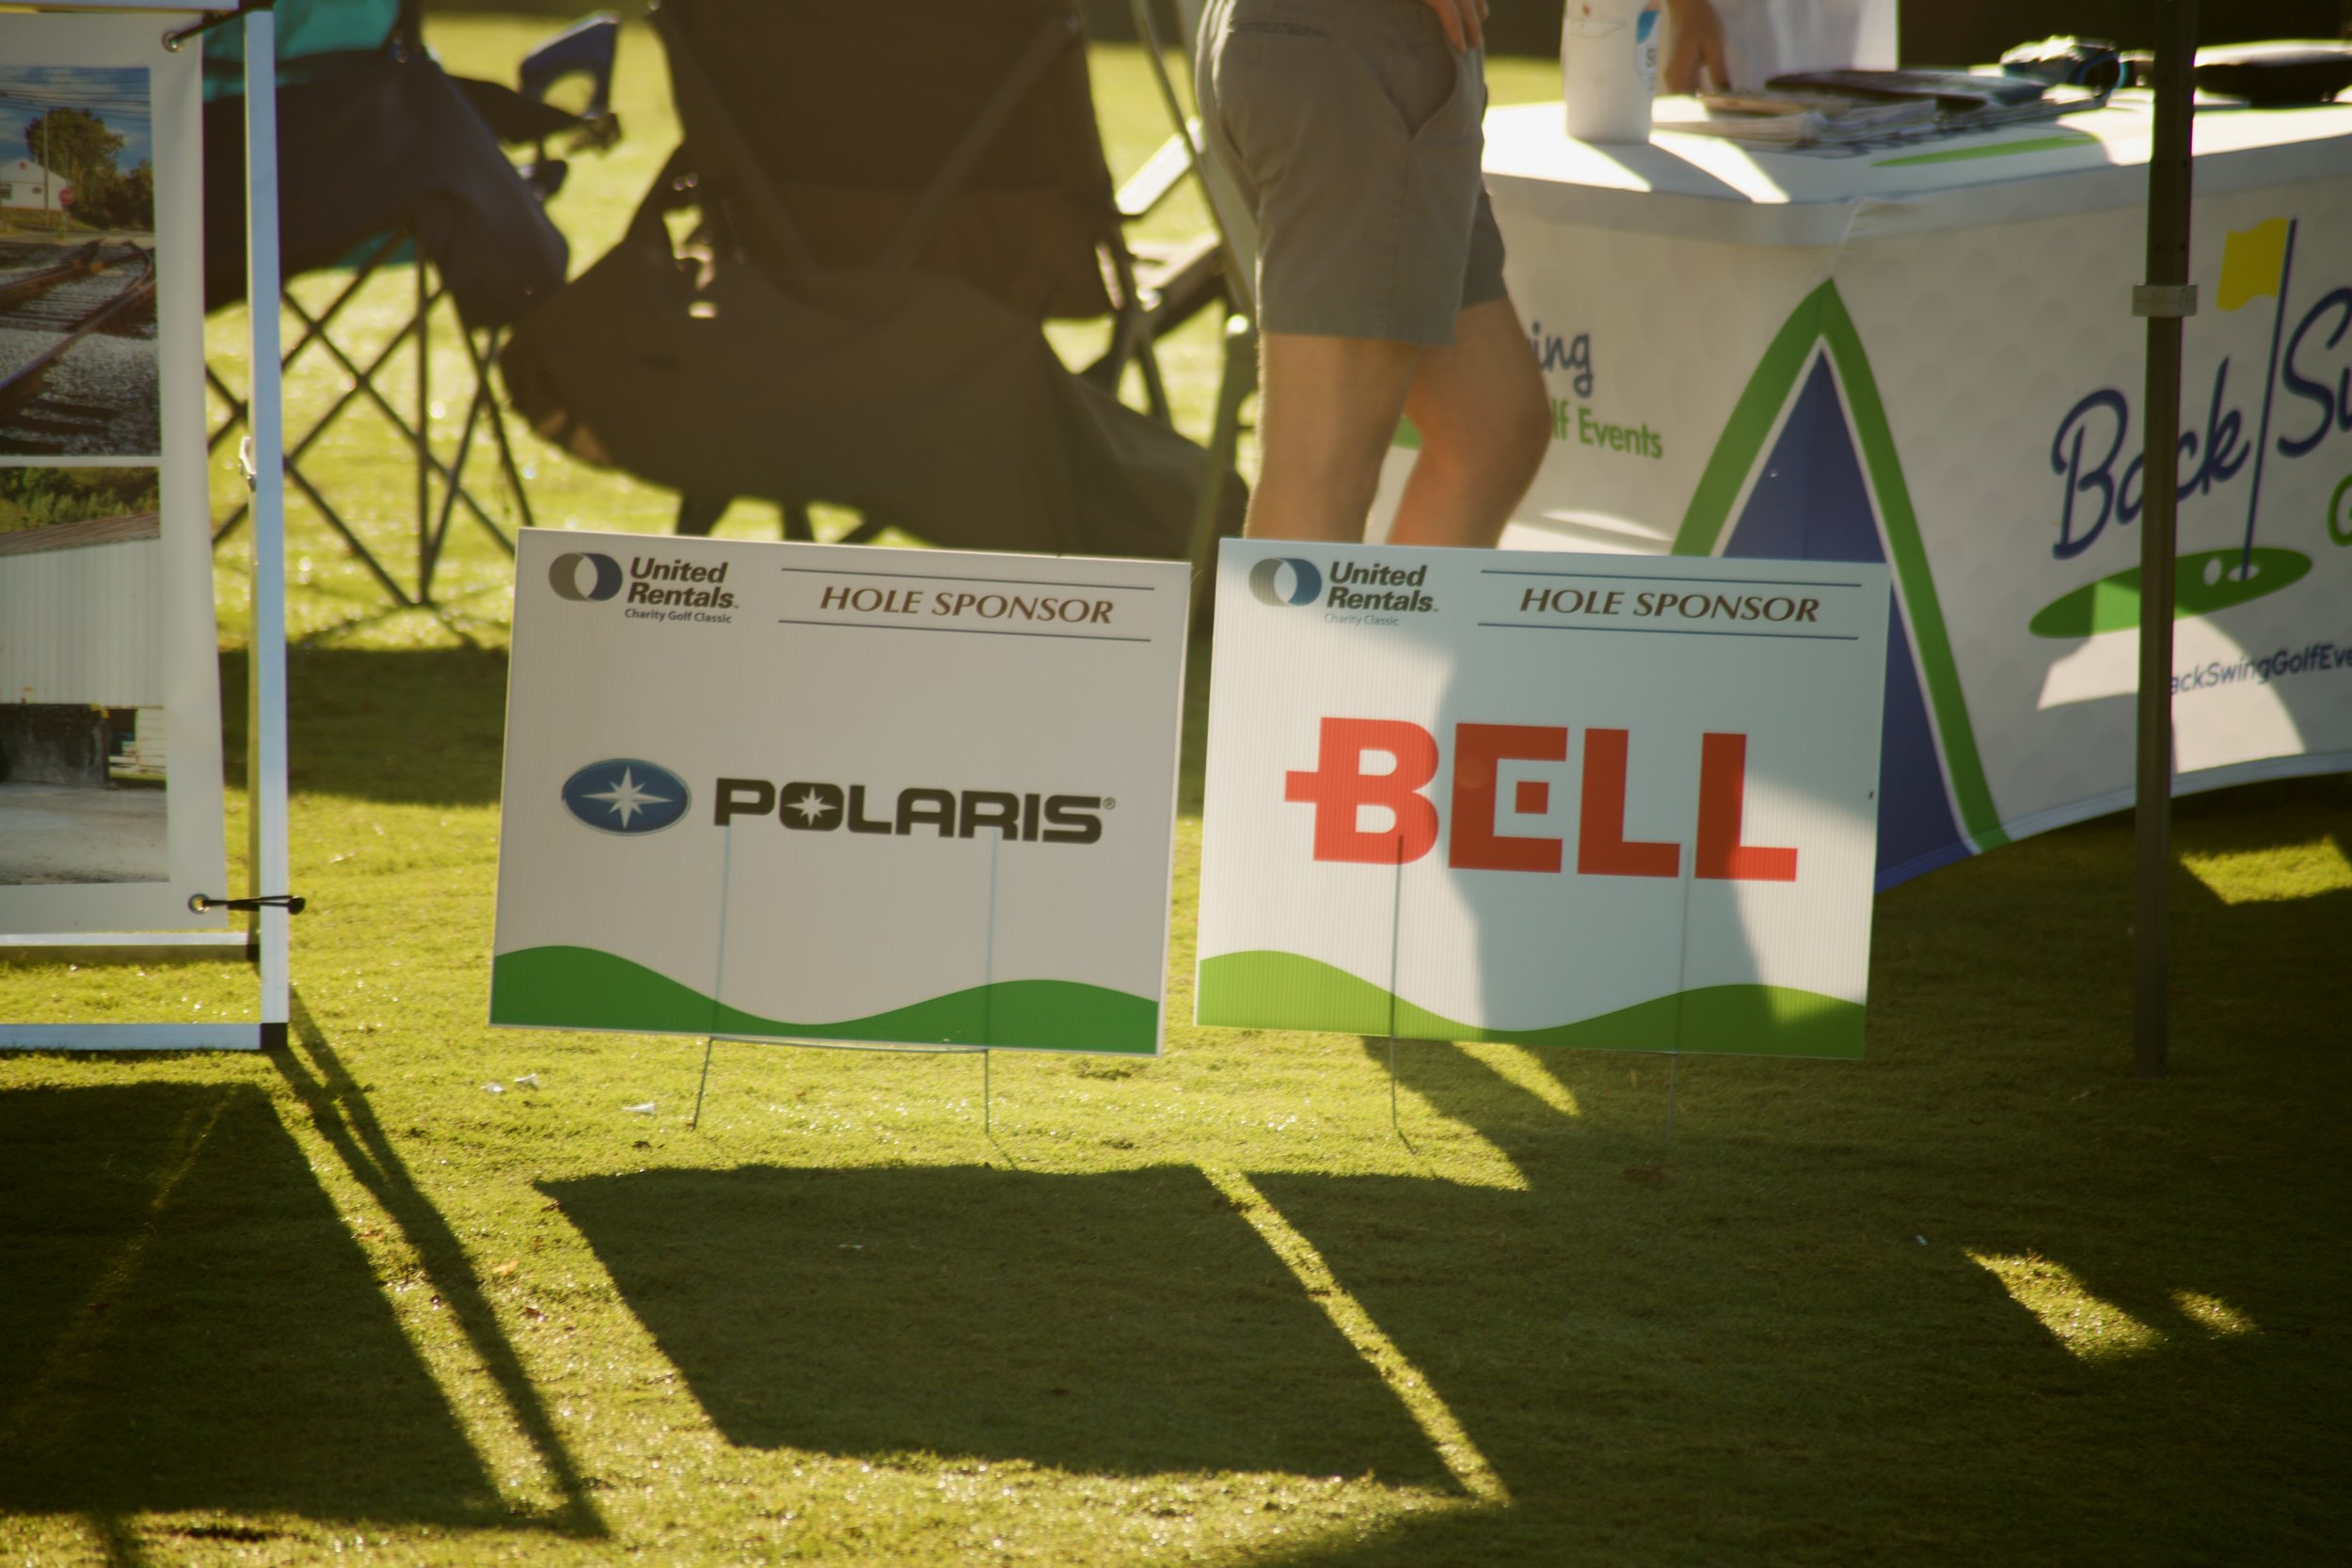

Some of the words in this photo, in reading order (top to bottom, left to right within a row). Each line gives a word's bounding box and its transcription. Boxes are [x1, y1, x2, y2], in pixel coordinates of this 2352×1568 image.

[1578, 406, 1663, 460] Events
[629, 557, 729, 584] United
[1329, 562, 1427, 587] United
[627, 581, 735, 610] Rentals
[819, 586, 924, 614] HOLE
[930, 592, 1114, 625] SPONSOR
[1327, 586, 1434, 612] Rentals
[1519, 588, 1626, 615] HOLE
[1632, 592, 1820, 623] SPONSOR
[625, 608, 665, 623] Charity
[668, 610, 692, 623] Golf
[693, 612, 732, 625] Classic
[1324, 612, 1362, 627] Charity
[1363, 615, 1400, 627] Classic
[1284, 716, 1798, 882] BELL
